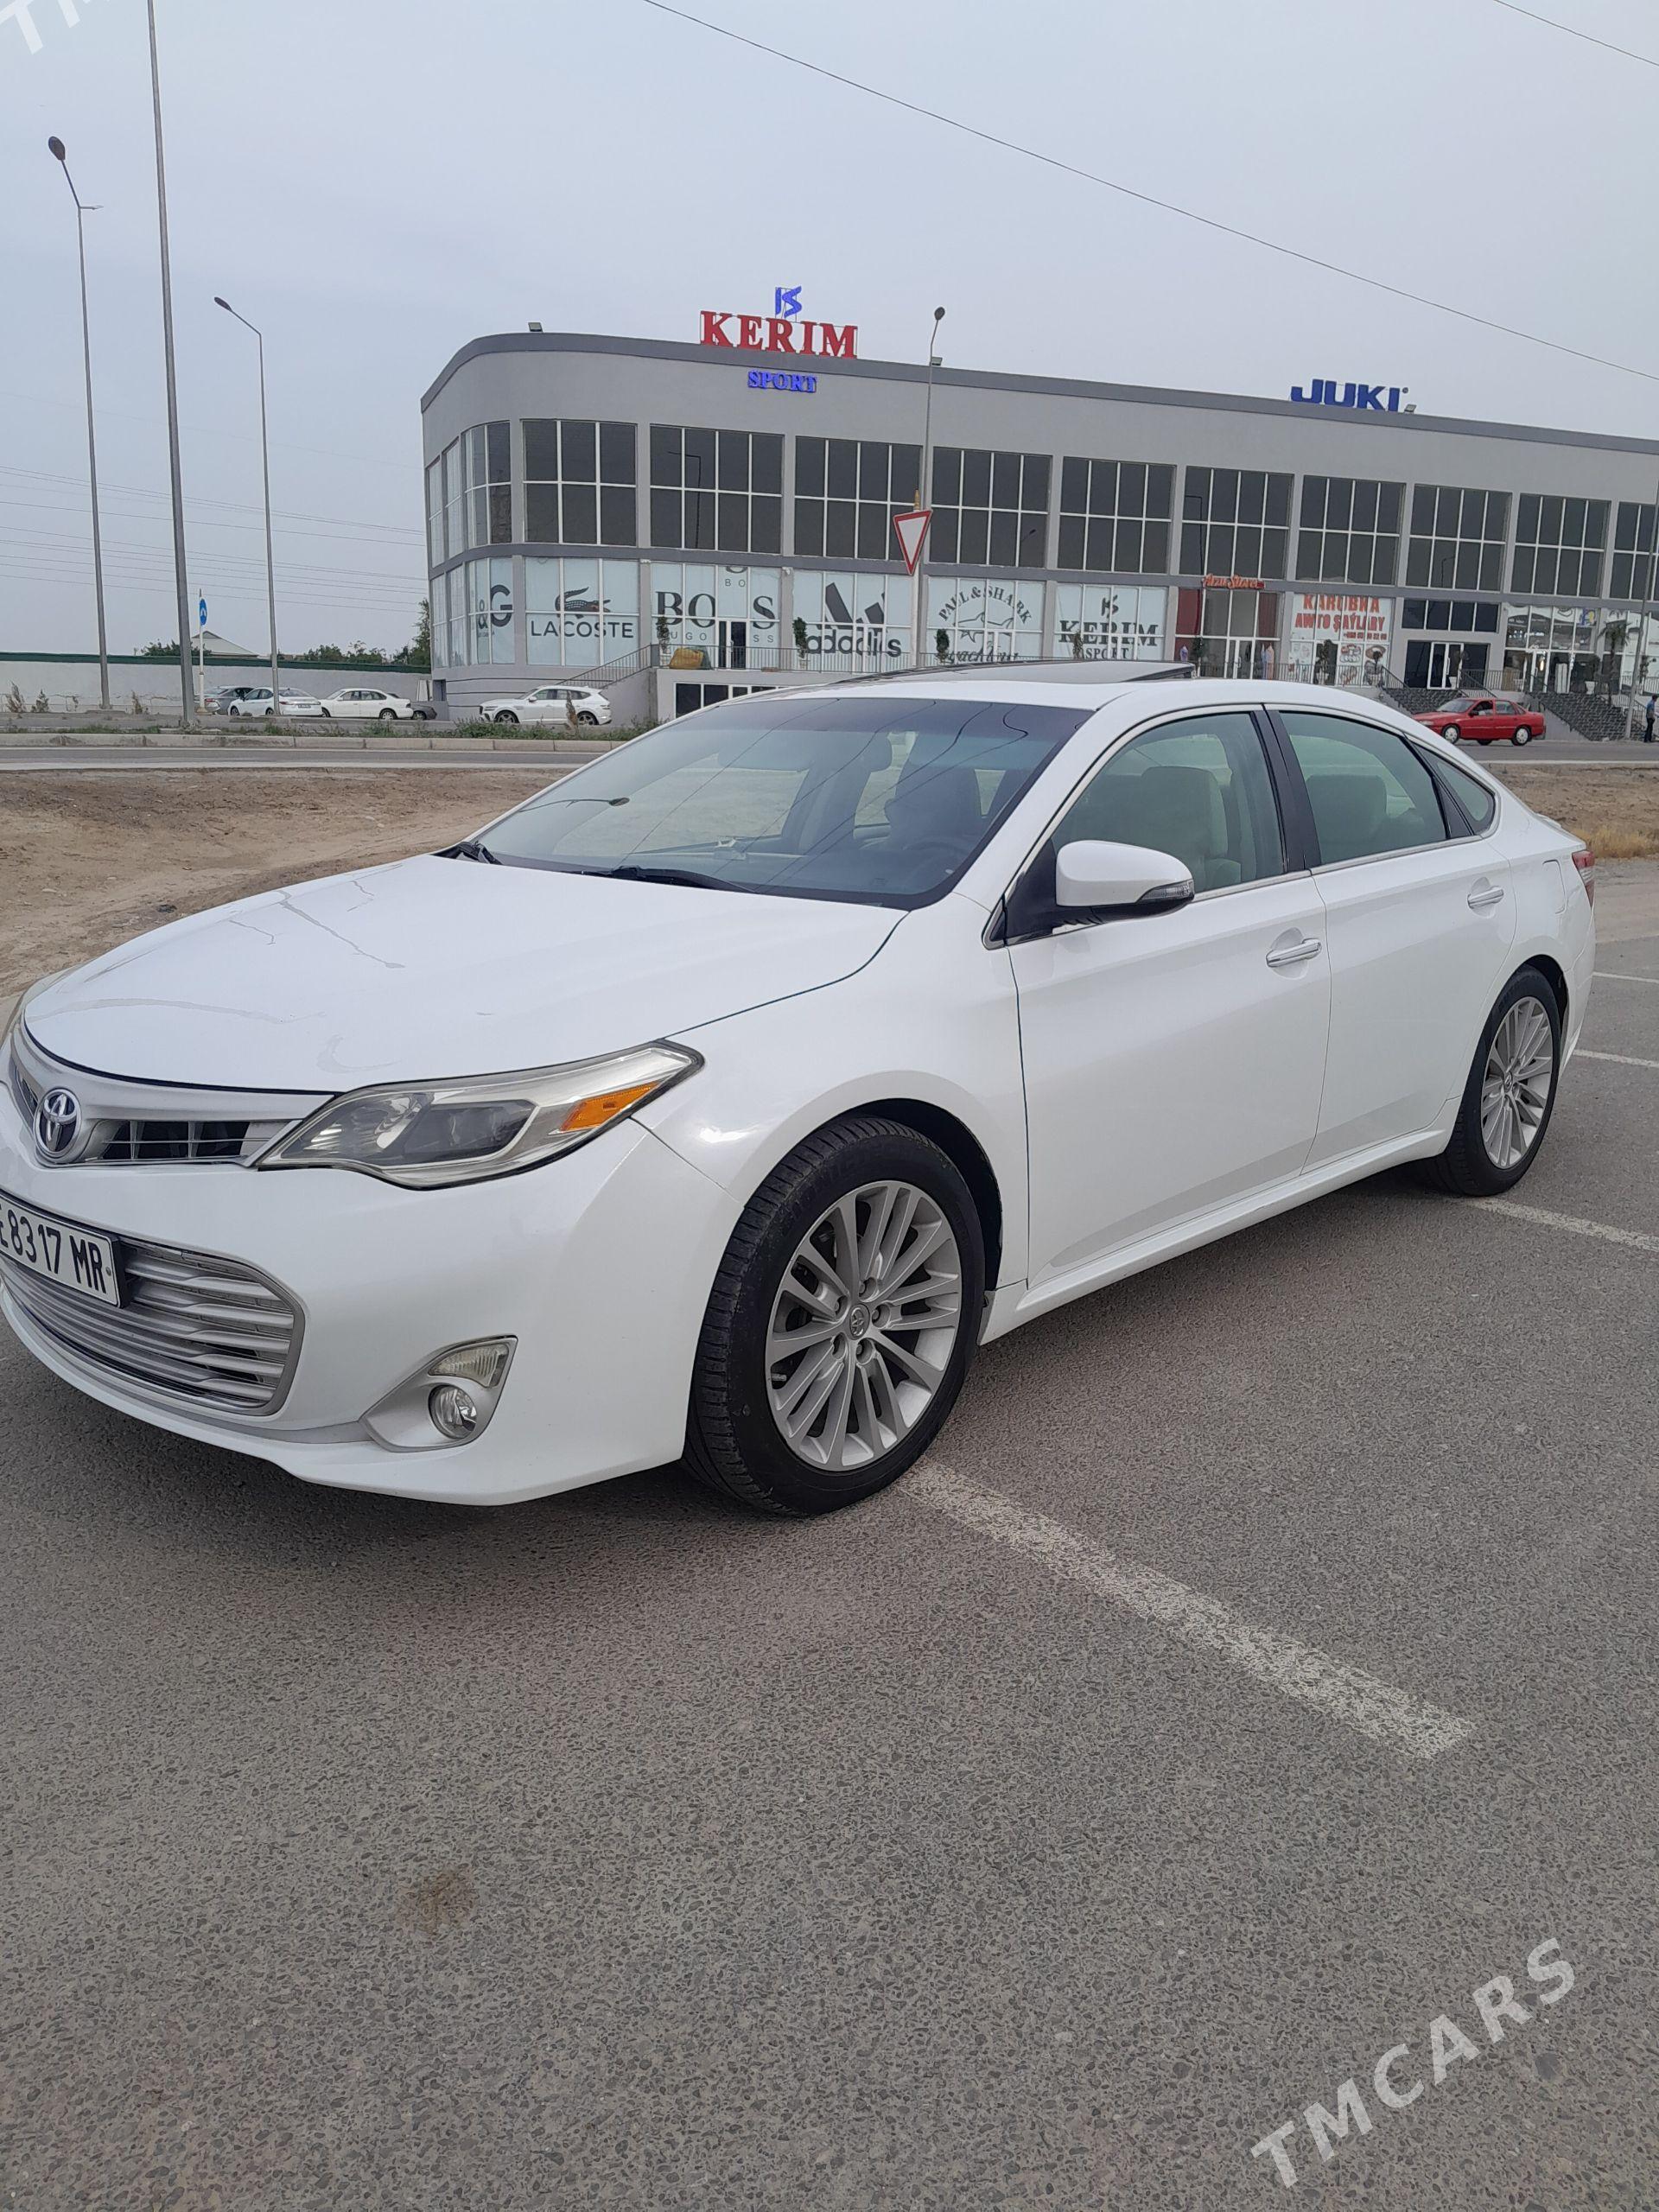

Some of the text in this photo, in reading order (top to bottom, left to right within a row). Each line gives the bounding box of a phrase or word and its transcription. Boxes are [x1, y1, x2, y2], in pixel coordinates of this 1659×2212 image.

[700, 310, 858, 359] KERIM
[747, 370, 817, 393] SPORT
[1291, 378, 1401, 412] JUKI
[970, 586, 982, 599] &
[531, 620, 634, 639] LACOSTE
[1058, 620, 1159, 647] KERIM
[8, 1209, 61, 1274] 8317
[69, 1235, 107, 1294] MR
